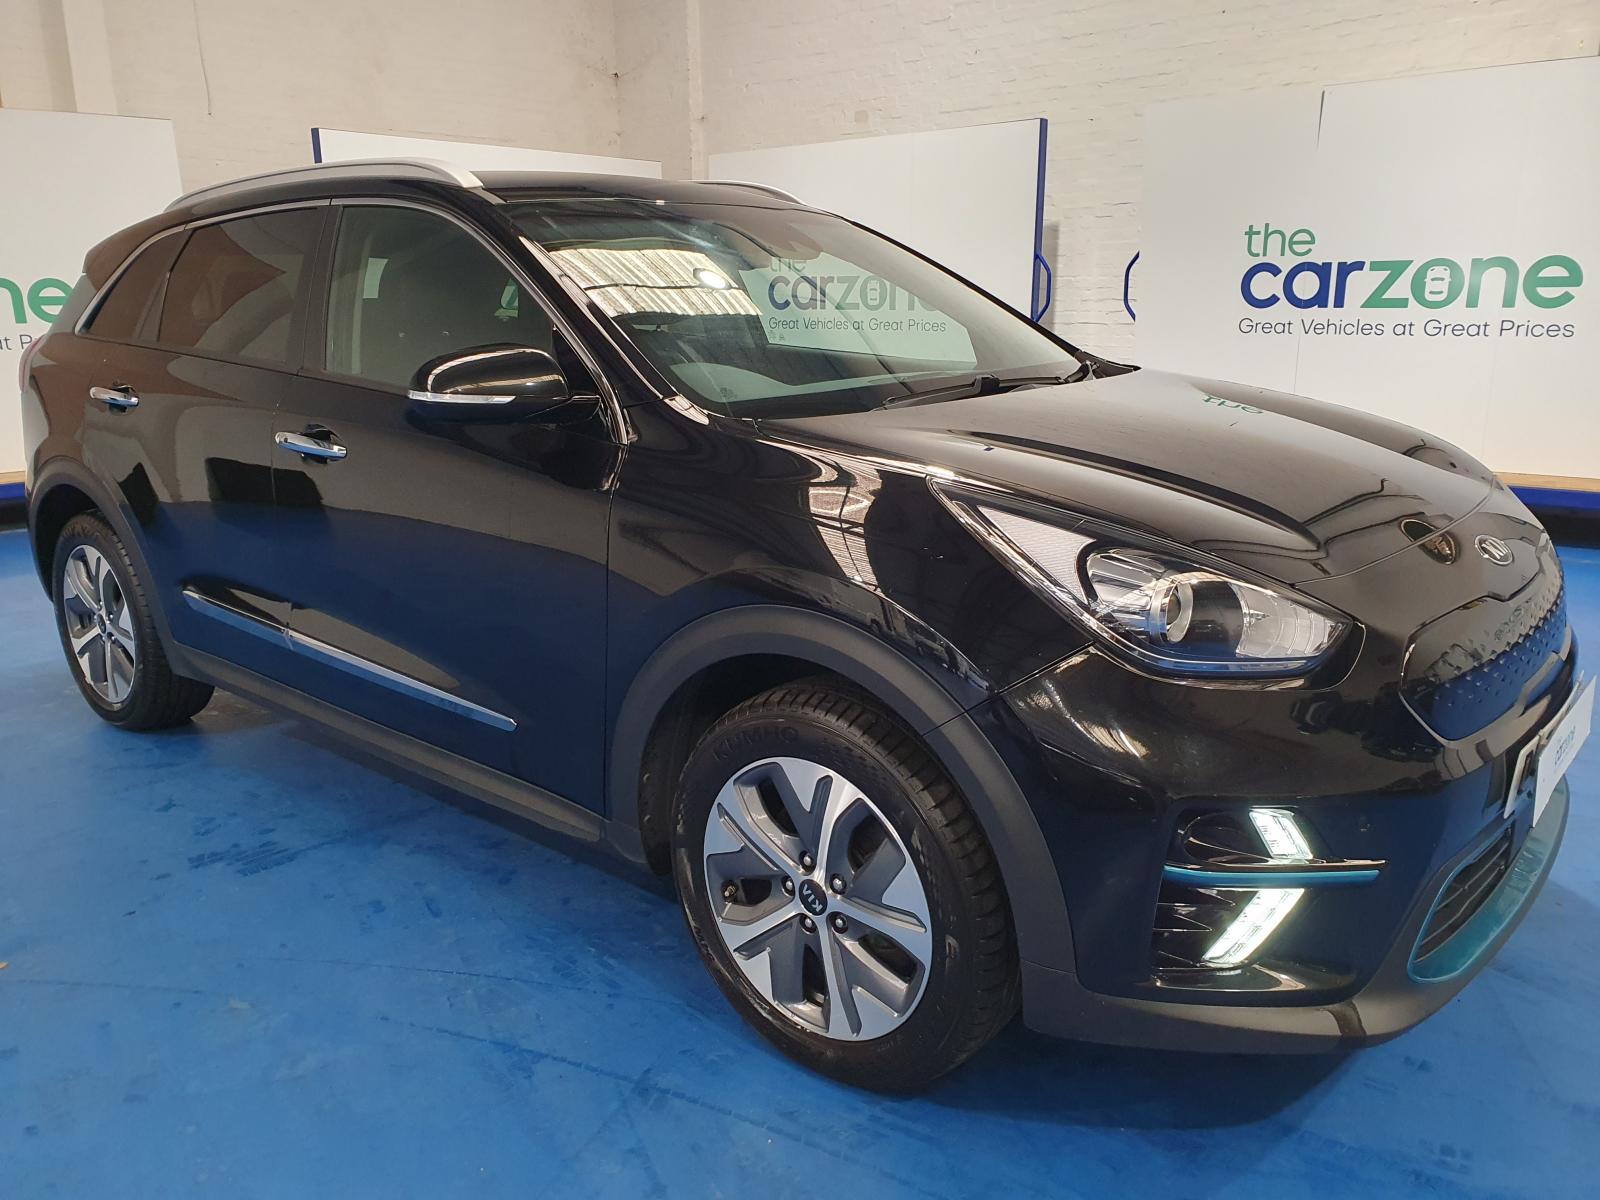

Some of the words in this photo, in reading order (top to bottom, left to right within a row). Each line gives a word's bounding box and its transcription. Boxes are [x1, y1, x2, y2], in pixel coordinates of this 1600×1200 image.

[1244, 222, 1316, 258] the
[768, 275, 938, 312] carzon
[1240, 254, 1584, 310] carzone
[768, 316, 800, 330] Great
[803, 317, 849, 331] Vehicles
[852, 319, 865, 331] at
[868, 318, 904, 332] Great
[908, 318, 947, 333] Prices
[1238, 317, 1294, 335] Great
[1301, 318, 1385, 337] Vehicles
[1392, 320, 1415, 338] at
[1423, 318, 1490, 338] Great
[1499, 319, 1576, 339] Prices
[802, 883, 823, 912] KIA
